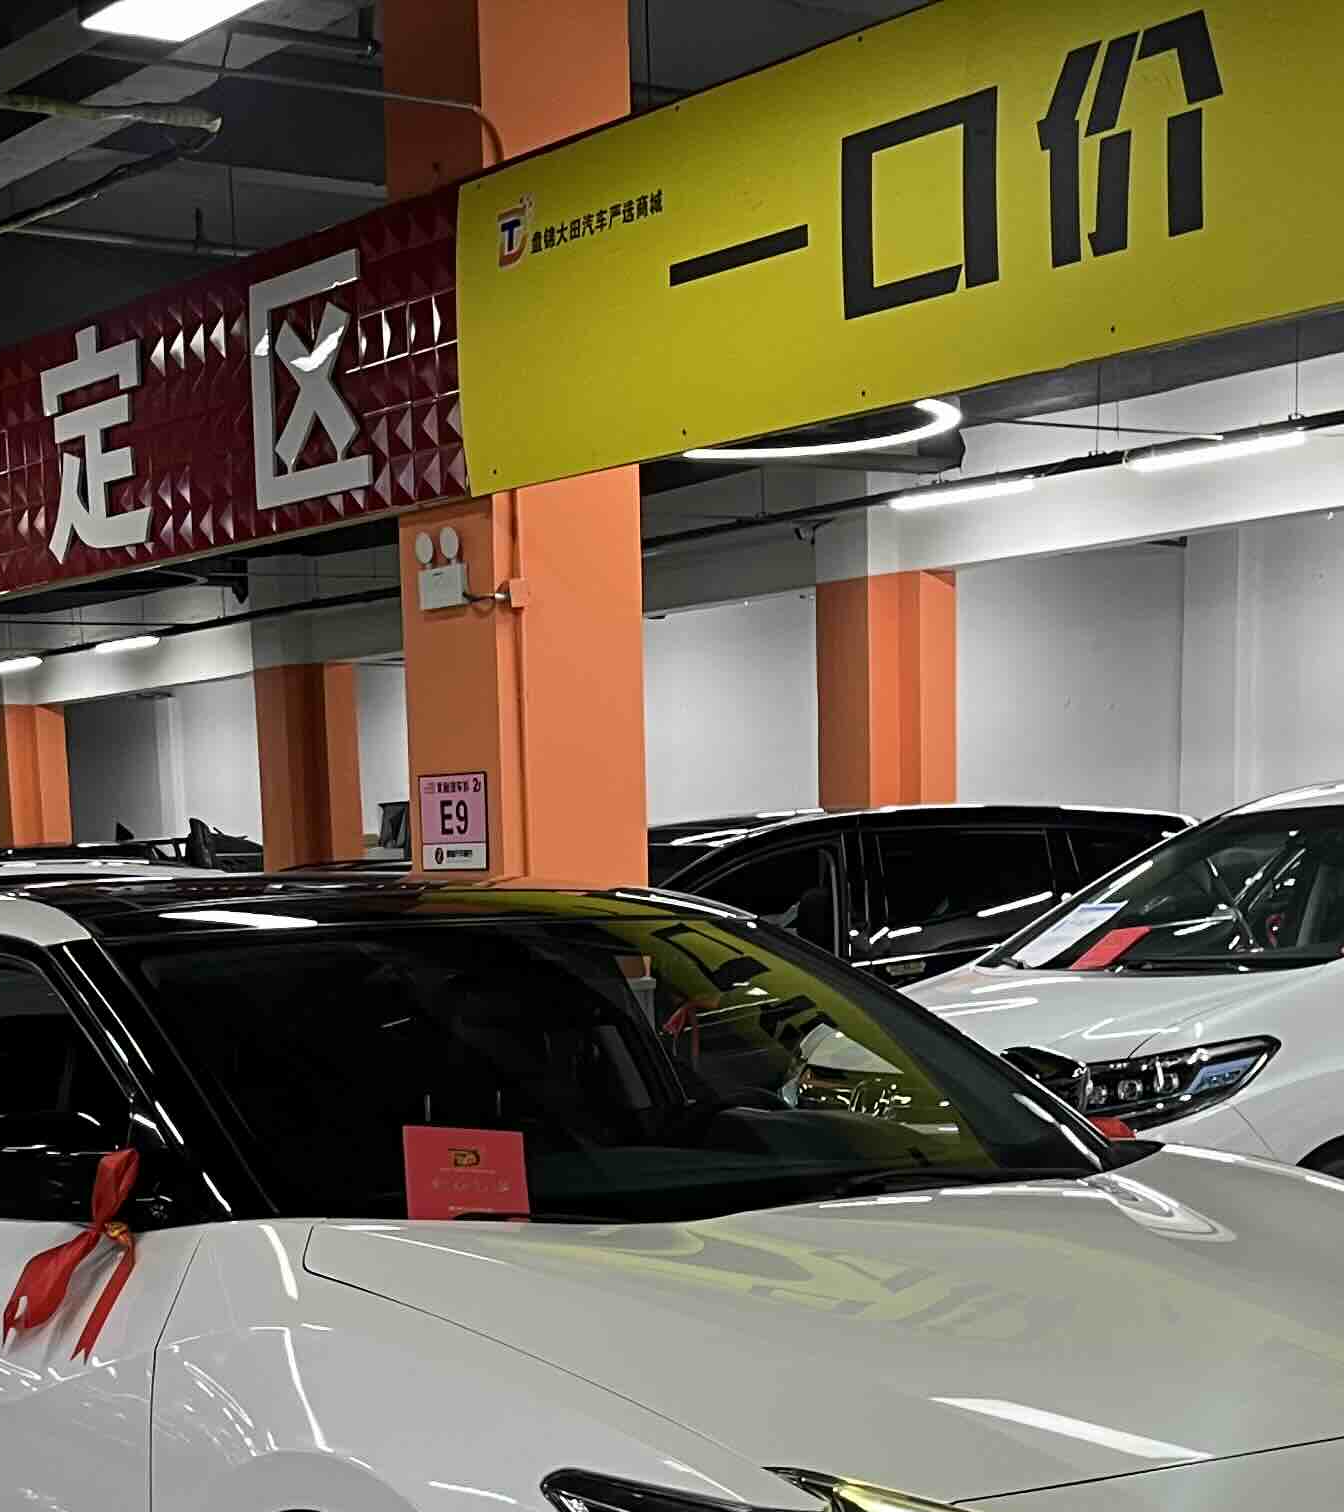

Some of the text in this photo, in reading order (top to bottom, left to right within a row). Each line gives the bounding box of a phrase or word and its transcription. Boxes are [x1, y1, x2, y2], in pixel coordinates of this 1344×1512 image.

[530, 188, 664, 254] 盘锦大田汽车严选商城
[439, 799, 469, 836] E9
